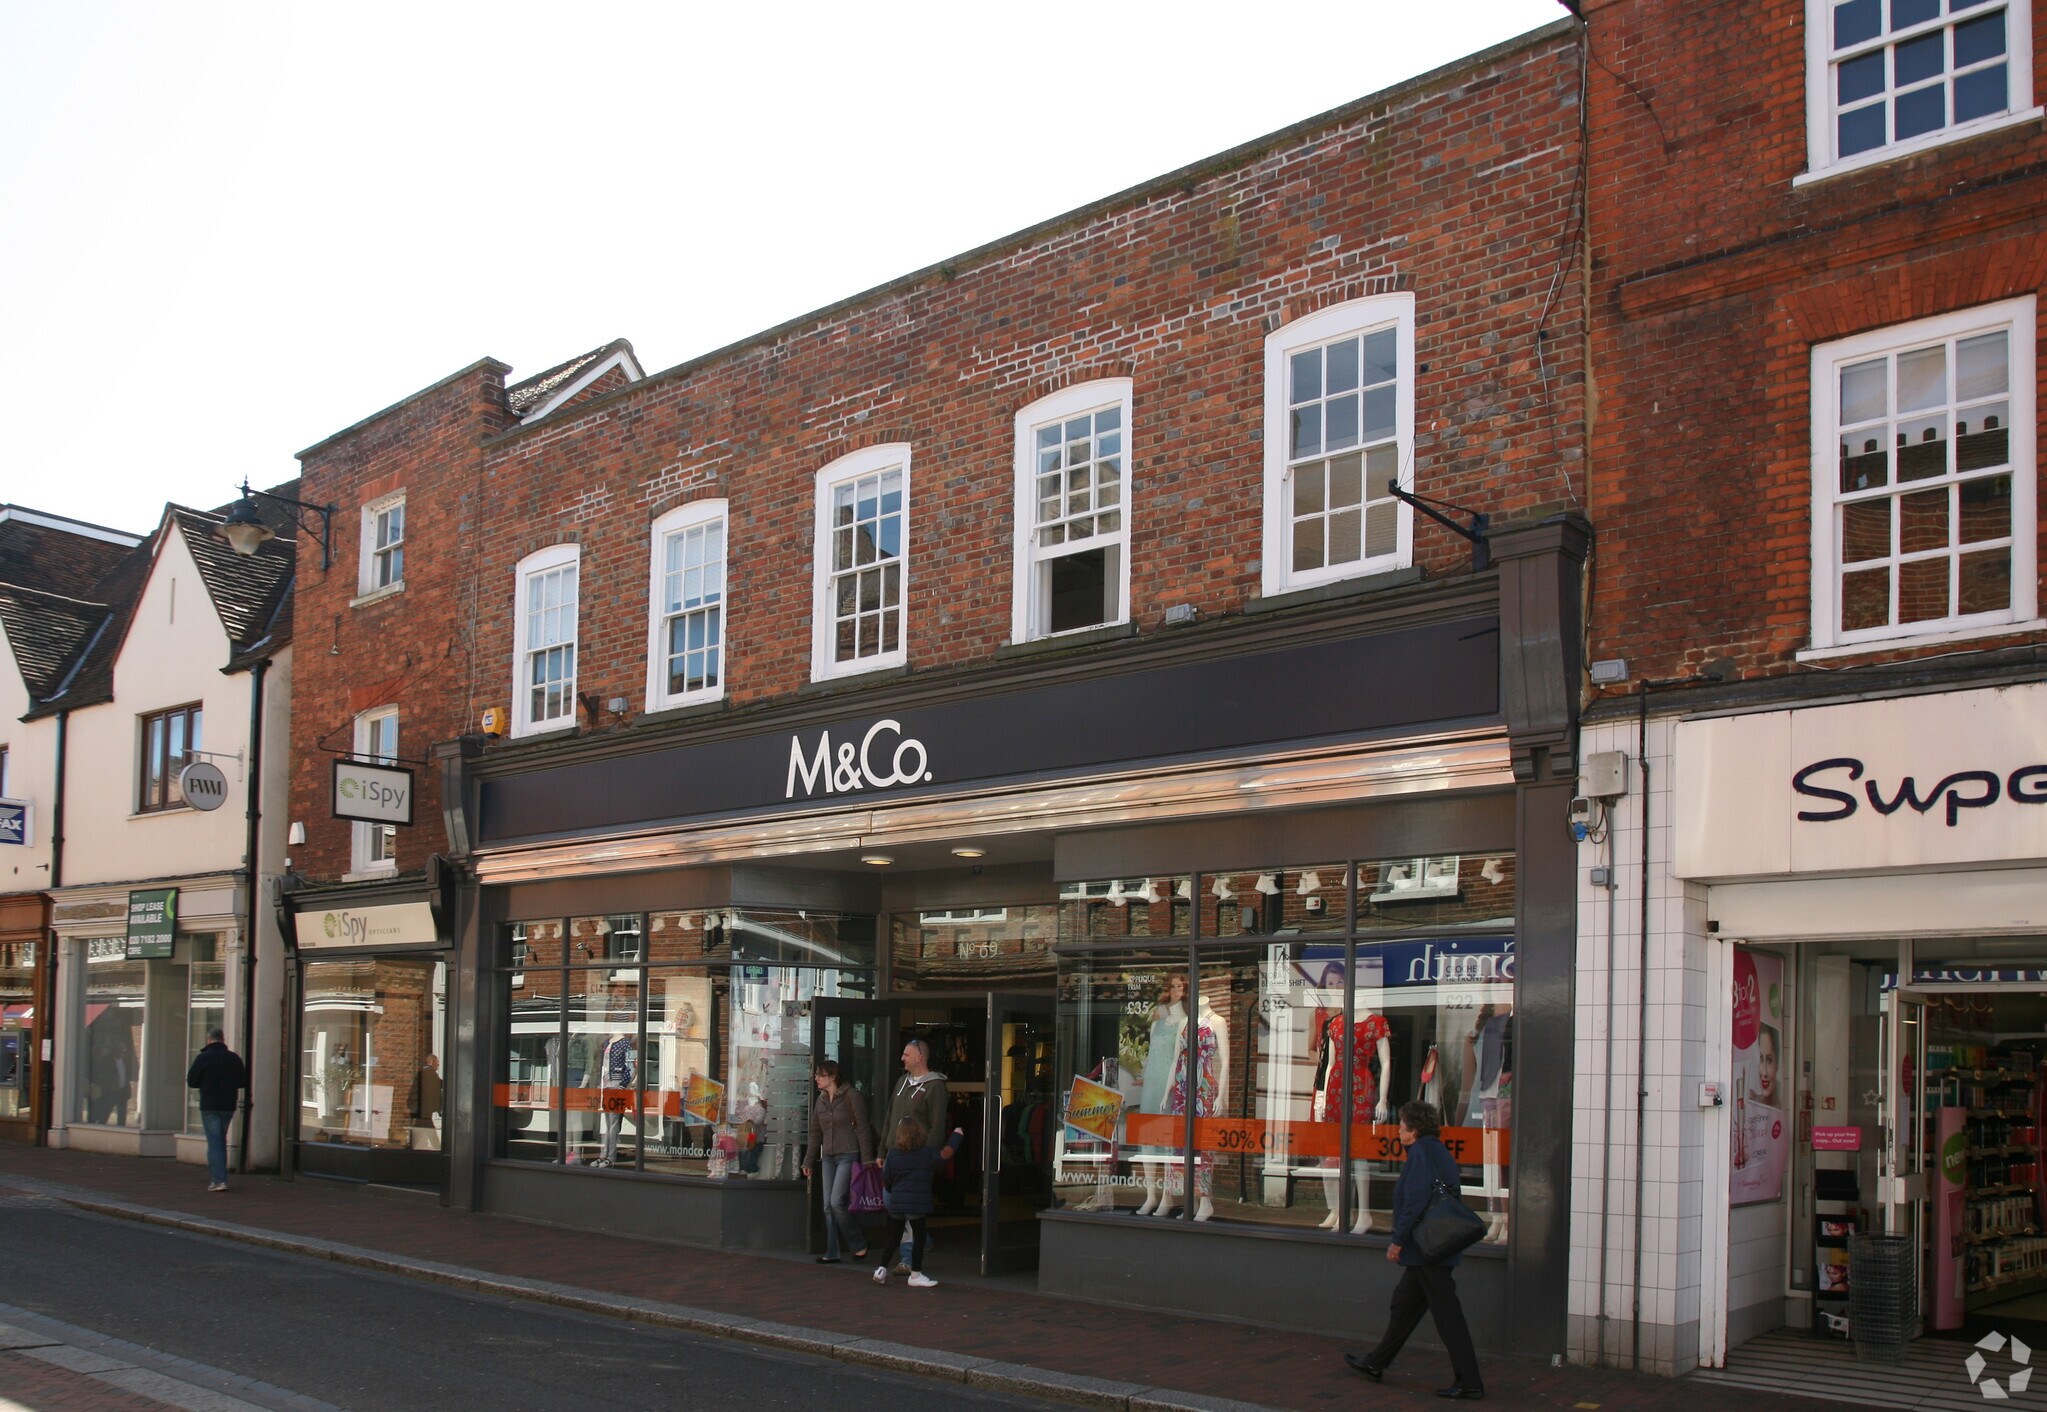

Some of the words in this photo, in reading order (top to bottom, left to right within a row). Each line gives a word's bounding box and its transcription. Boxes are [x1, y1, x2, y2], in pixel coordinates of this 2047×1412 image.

[785, 719, 933, 798] M&Co.
[362, 780, 405, 809] iSpy
[130, 903, 145, 912] SHOP
[145, 901, 165, 911] LEASE
[129, 913, 162, 924] AVAILABLE
[338, 911, 367, 944] iSpy
[368, 927, 401, 936] OPTICIANS
[980, 941, 998, 958] 69
[1289, 979, 1306, 987] SHIFT
[1748, 974, 1756, 1003] 2
[1126, 1001, 1149, 1015] £35
[608, 1097, 626, 1111] OFF
[1218, 1129, 1255, 1150] 30%
[1260, 1132, 1294, 1151] OFF
[1378, 1137, 1401, 1157] 30
[1446, 1139, 1465, 1159] FF
[644, 1143, 724, 1158] www.mandco.com
